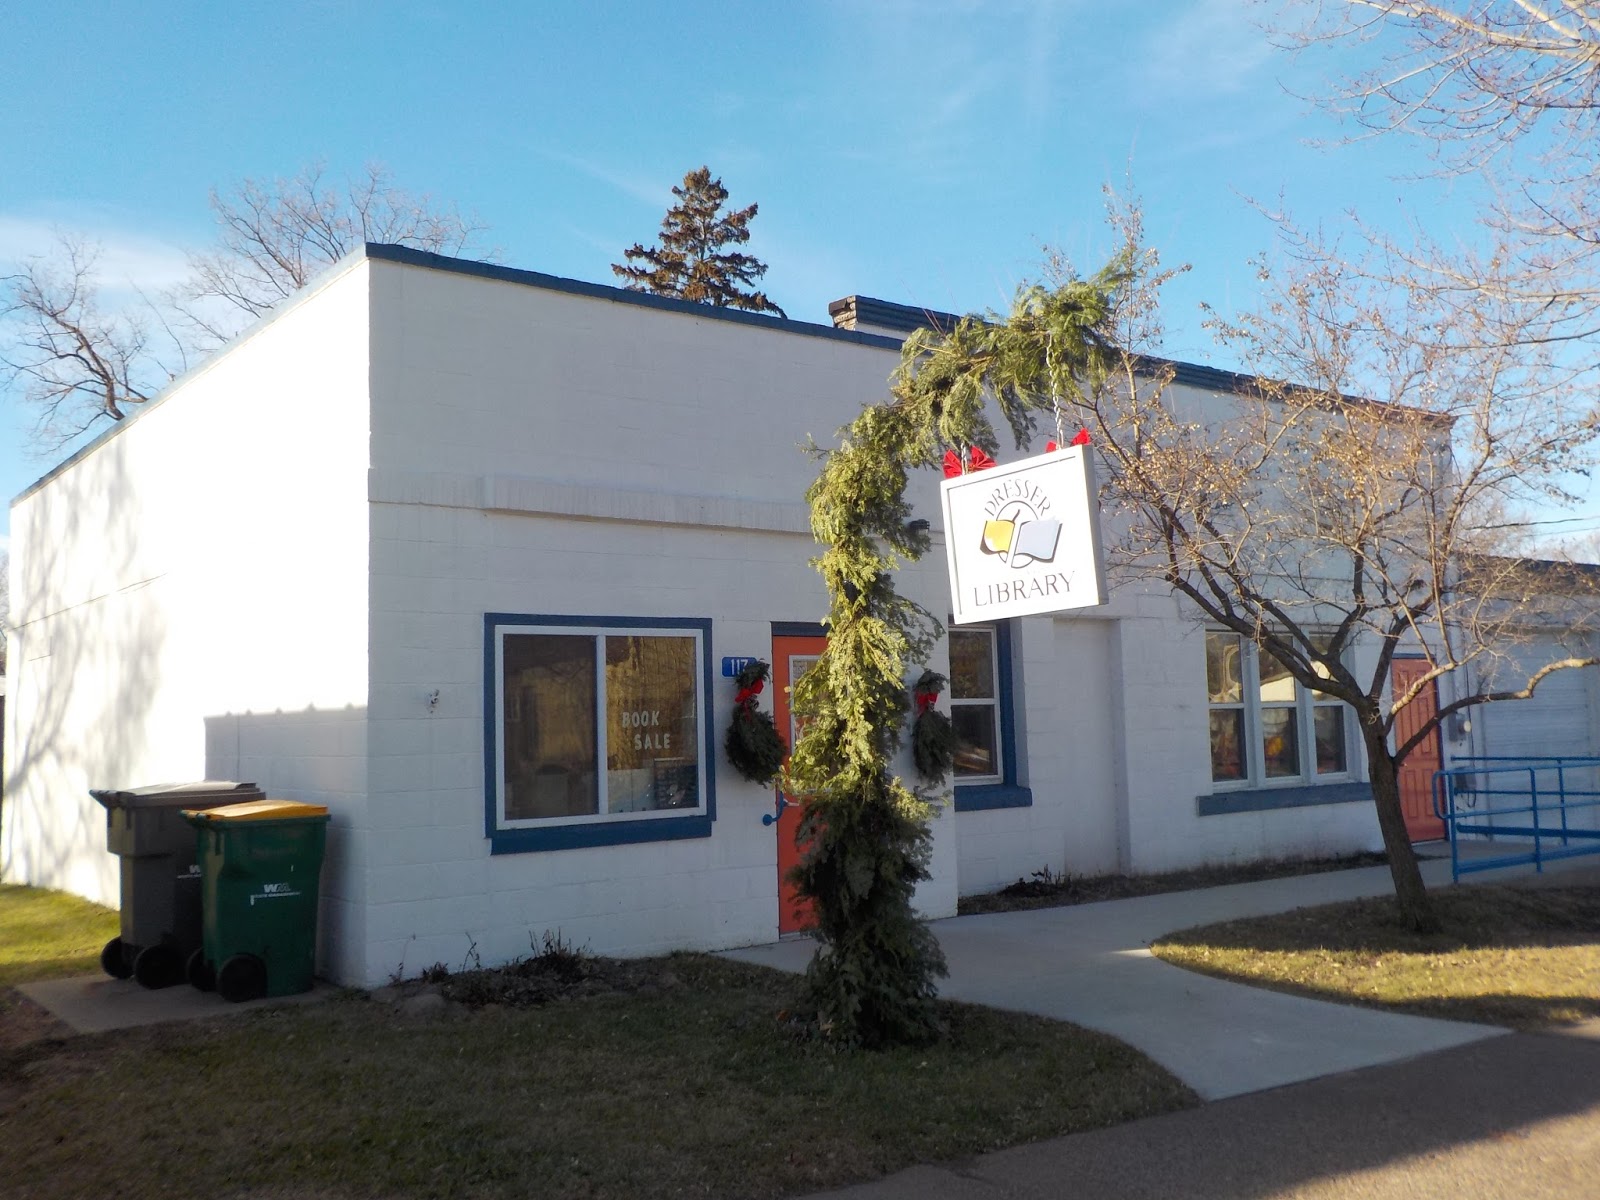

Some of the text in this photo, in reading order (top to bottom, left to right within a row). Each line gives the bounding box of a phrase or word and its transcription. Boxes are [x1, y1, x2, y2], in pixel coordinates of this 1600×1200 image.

[984, 479, 1051, 517] DRESSER
[974, 570, 1076, 607] LIBRARY
[622, 710, 660, 728] BOOK
[634, 733, 671, 750] SALE
